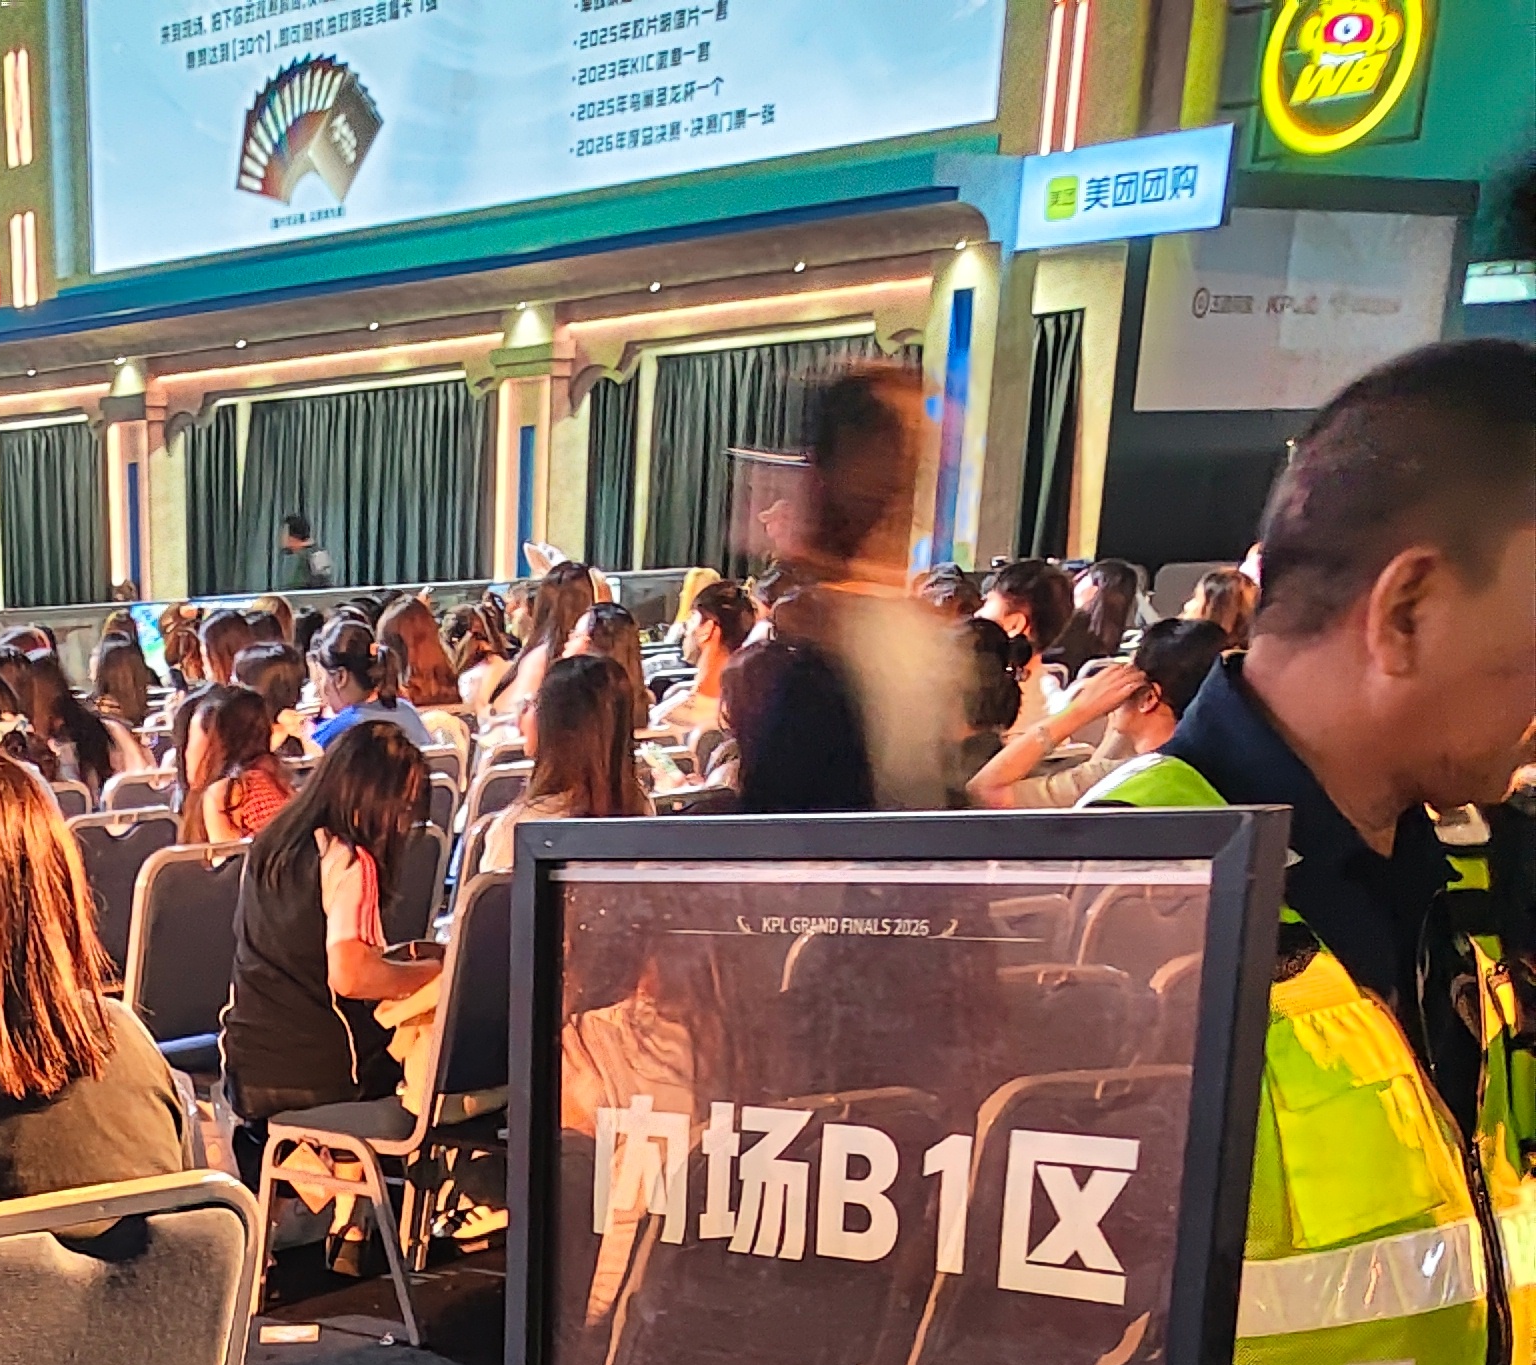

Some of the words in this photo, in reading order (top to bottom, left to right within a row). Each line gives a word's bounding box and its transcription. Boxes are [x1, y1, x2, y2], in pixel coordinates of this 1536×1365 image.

[1289, 52, 1389, 106] WB
[1082, 164, 1199, 212] 美团团购
[761, 916, 789, 934] KPL
[790, 917, 840, 936] GRAND
[841, 917, 891, 936] FINALS
[892, 918, 930, 937] 2026
[594, 1094, 1142, 1306] 内场B1区
